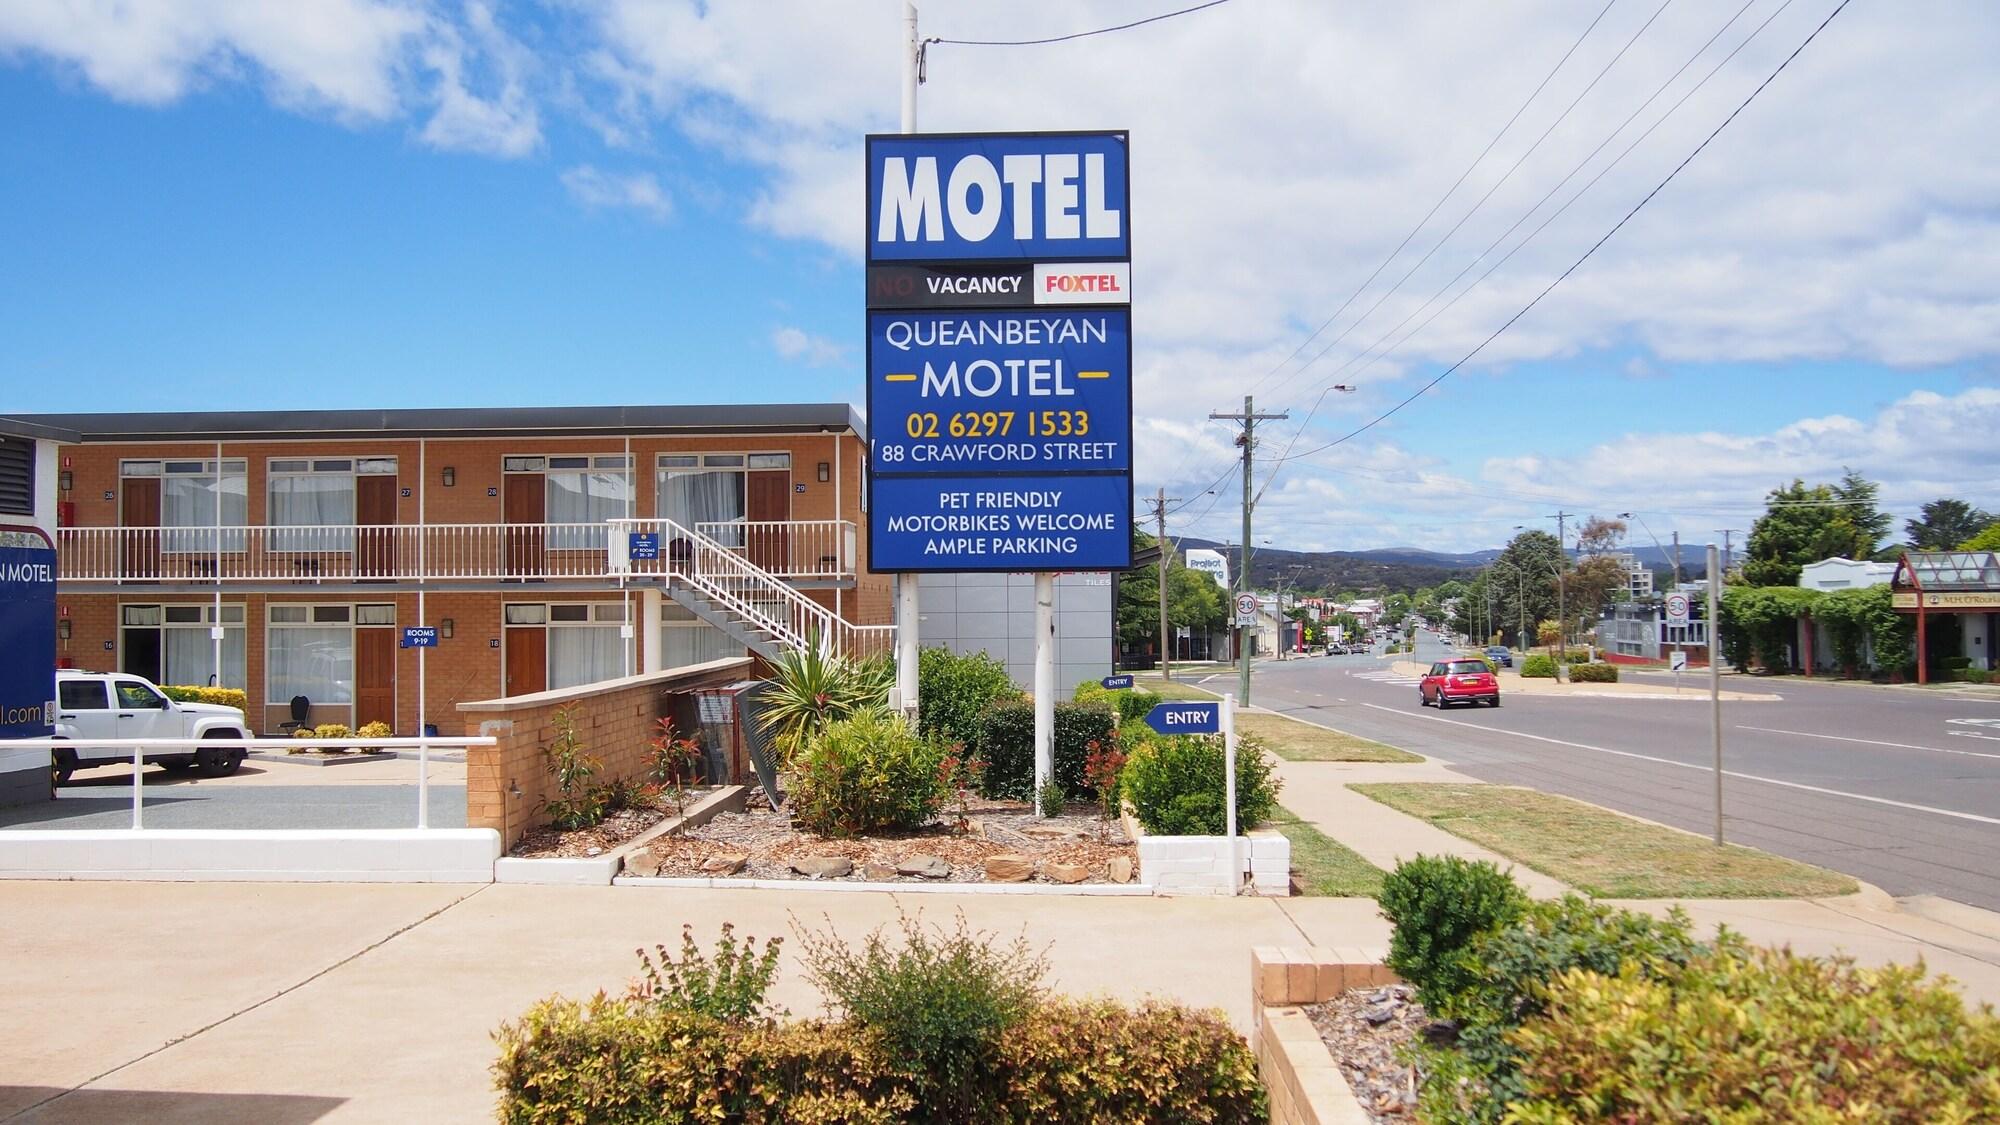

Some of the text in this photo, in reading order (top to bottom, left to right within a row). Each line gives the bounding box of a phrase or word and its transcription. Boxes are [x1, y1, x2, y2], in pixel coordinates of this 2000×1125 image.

[877, 153, 1120, 242] MOTEL
[876, 276, 1022, 296] NO VACANCY
[1046, 275, 1121, 292] FOXTEL
[886, 318, 1106, 350] QUEANBEYAN
[921, 359, 1075, 398] MOTEL
[906, 410, 1089, 438] 02 6297 1533
[881, 442, 1117, 462] 88 CRAWFORD STREET
[940, 491, 1062, 509] PET FRIENDLY
[888, 513, 1115, 532] MOTORBIKES WELCOME
[924, 536, 1078, 555] AMPLE PARKING
[8, 563, 53, 582] MOTEL
[1240, 601, 1254, 609] 50
[1670, 602, 1685, 611] 50
[407, 629, 435, 637] ROOMS
[413, 637, 429, 645] 9-19
[1108, 678, 1128, 686] ENTRY
[1166, 711, 1210, 724] ENTRY
